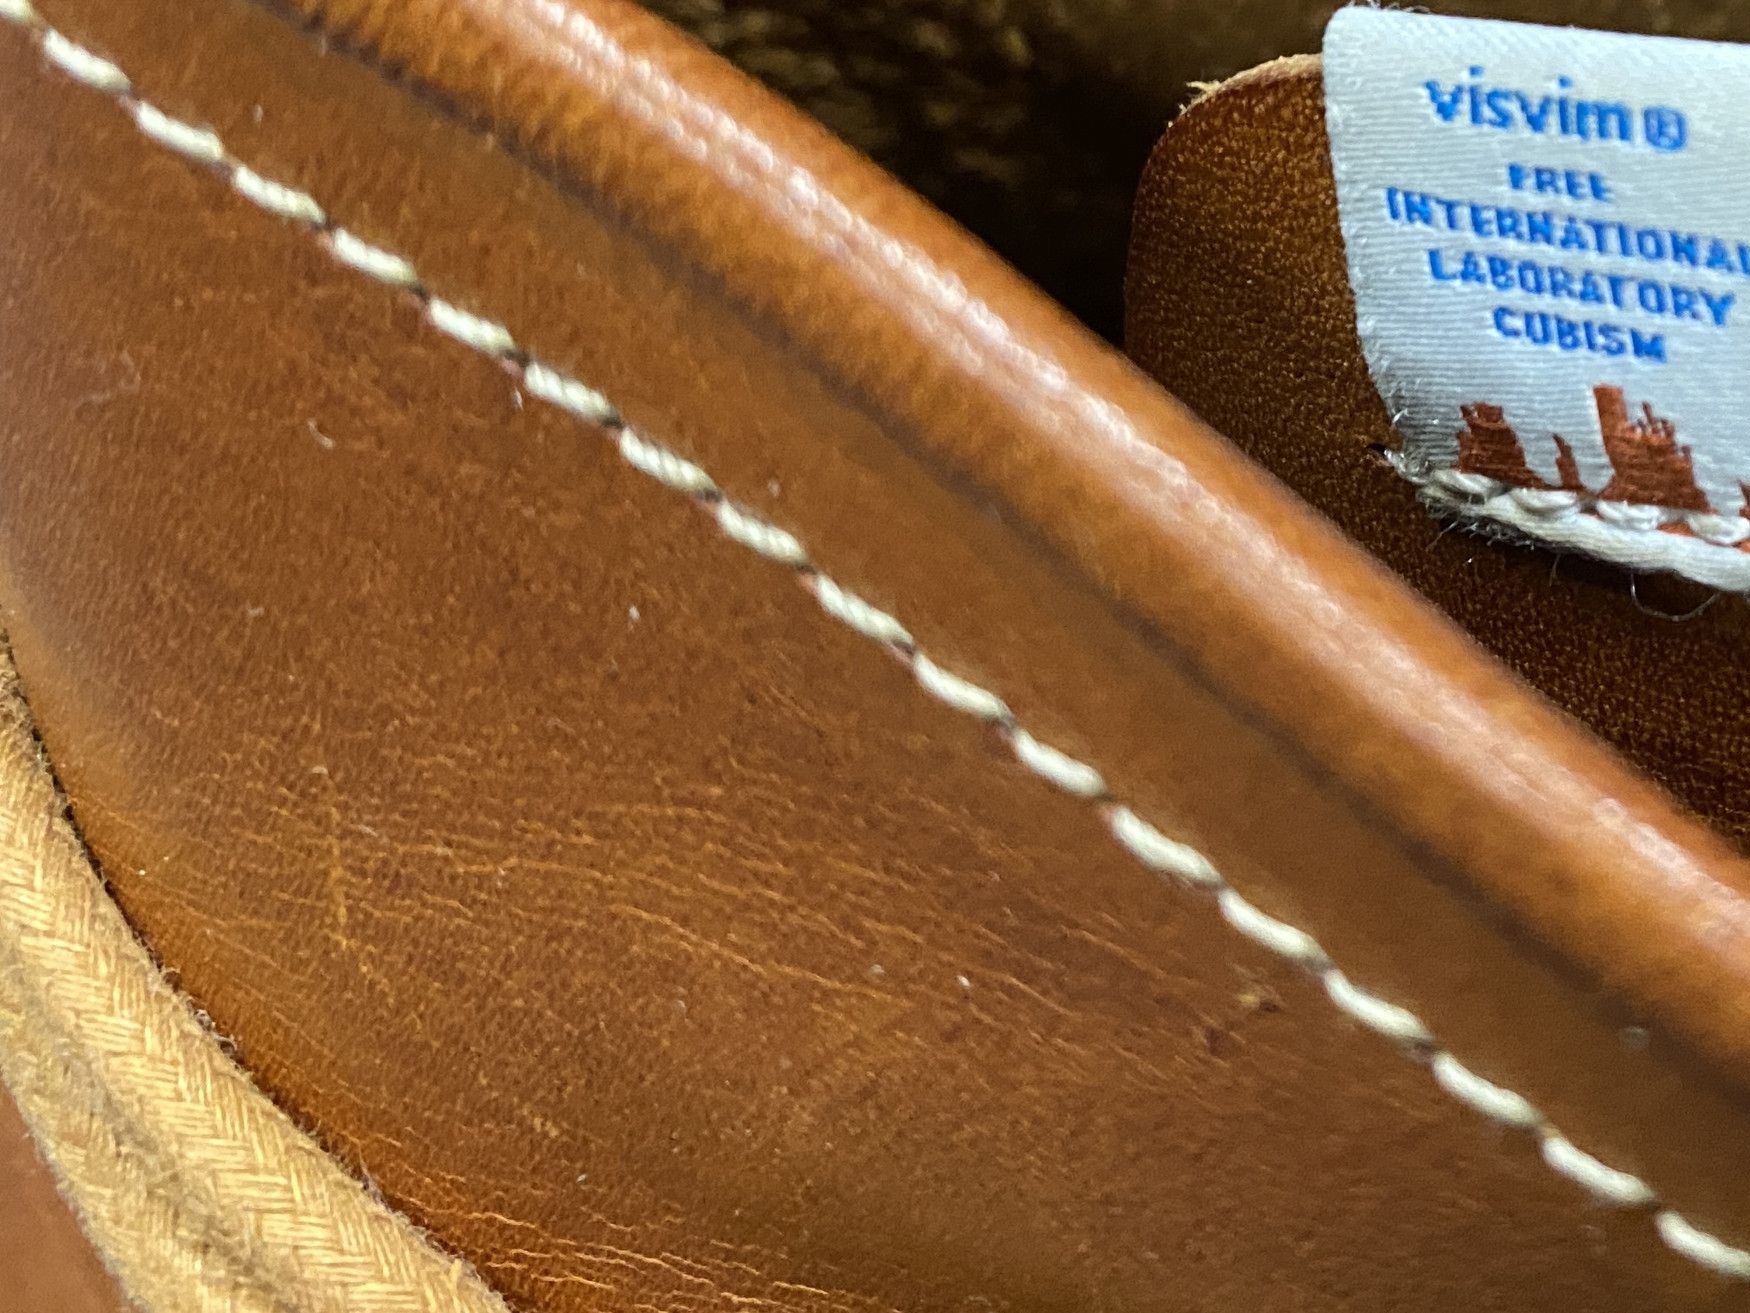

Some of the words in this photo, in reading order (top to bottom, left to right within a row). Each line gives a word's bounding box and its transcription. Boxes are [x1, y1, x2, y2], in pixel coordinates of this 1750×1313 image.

[1508, 163, 1616, 204] FREE
[1428, 249, 1736, 327] LABORATORY
[1493, 307, 1667, 364] CUBISM
